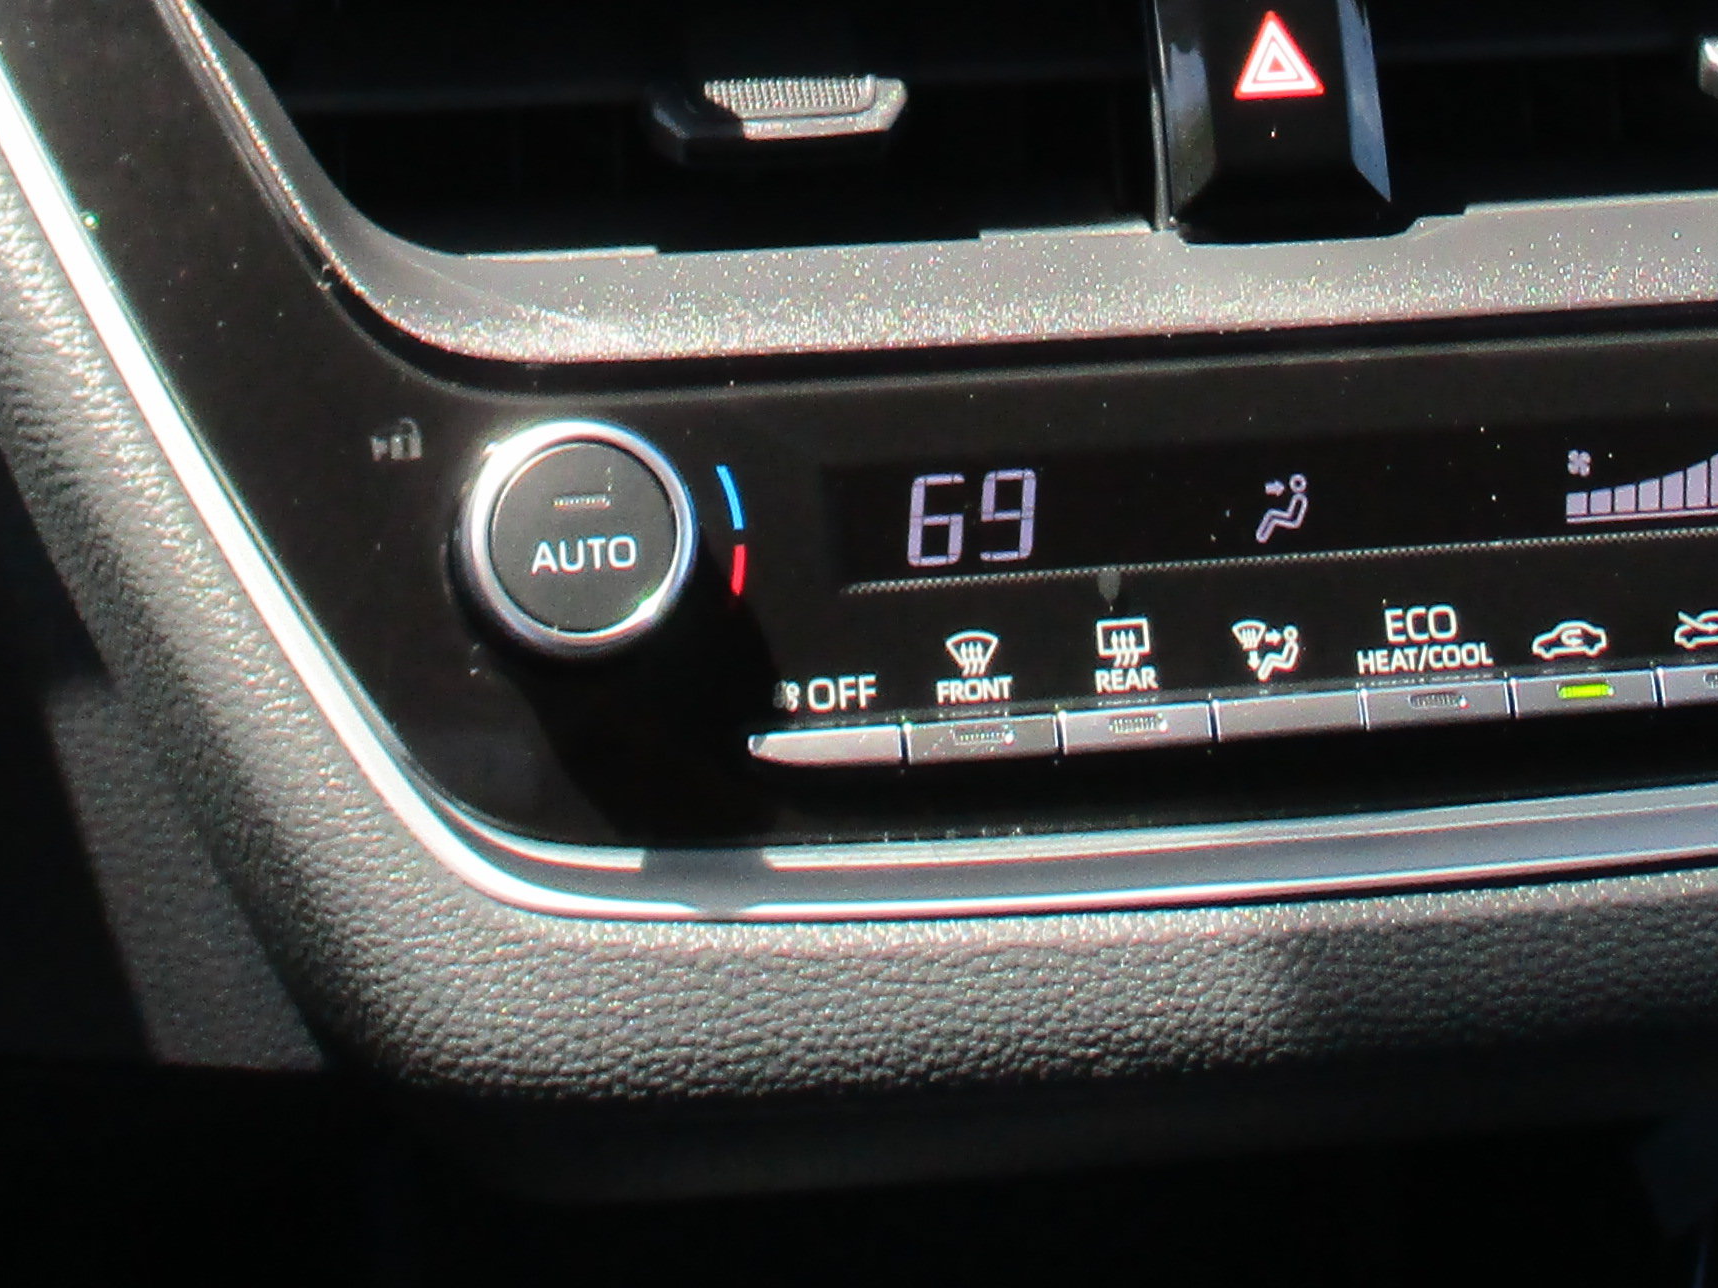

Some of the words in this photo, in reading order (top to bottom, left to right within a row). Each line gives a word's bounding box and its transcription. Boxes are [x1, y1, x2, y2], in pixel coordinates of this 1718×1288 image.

[907, 469, 1037, 567] 69
[531, 536, 637, 574] AUTO
[1385, 605, 1457, 643] ECO
[1357, 643, 1492, 674] HEAT/COOL
[807, 675, 876, 711] OFF
[937, 675, 1011, 703] FRONT
[1095, 667, 1157, 692] REAR
